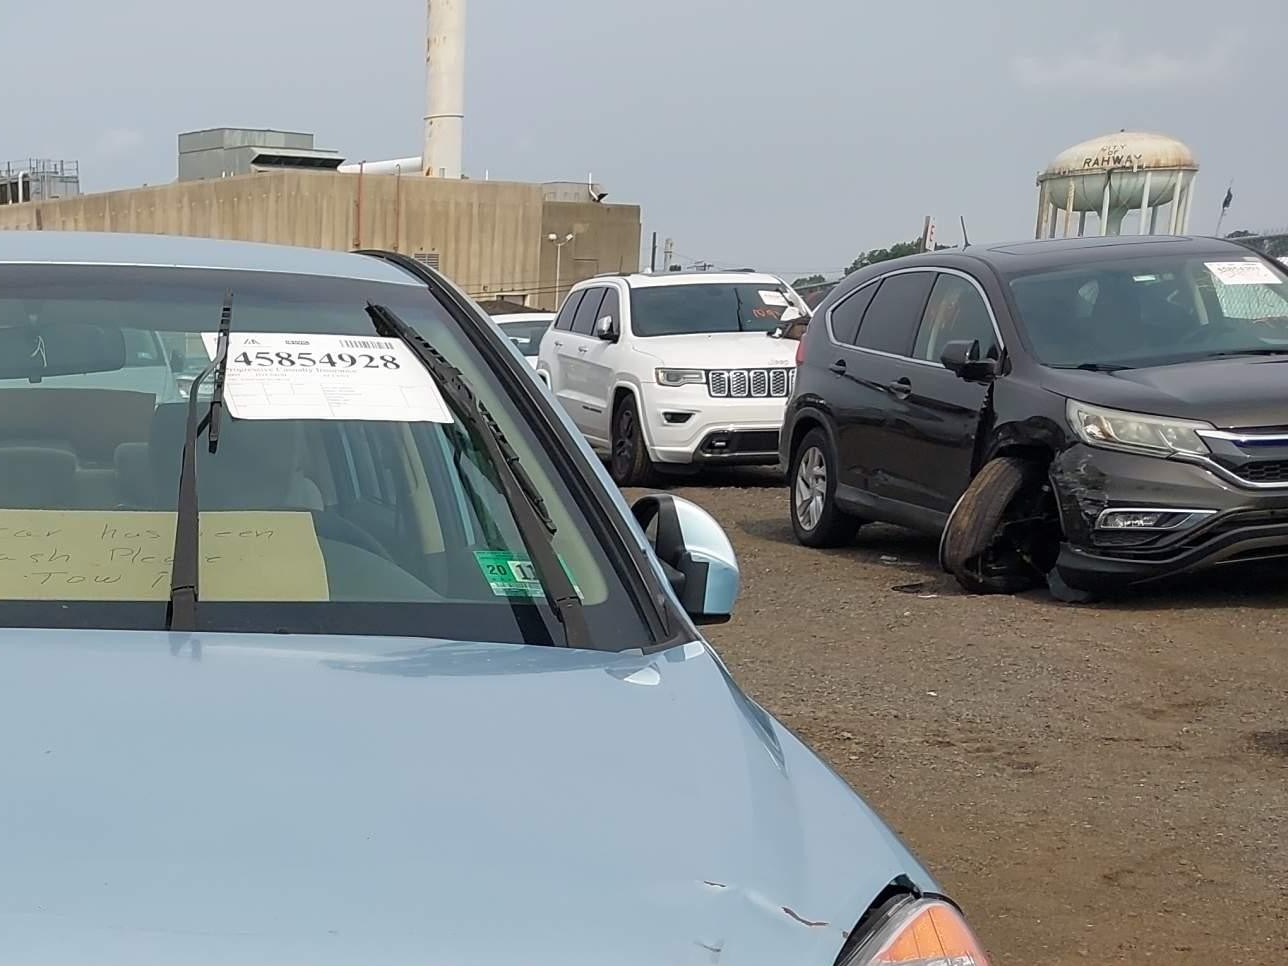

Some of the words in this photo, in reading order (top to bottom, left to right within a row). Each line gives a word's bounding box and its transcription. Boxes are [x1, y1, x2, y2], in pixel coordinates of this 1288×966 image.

[1082, 154, 1142, 168] RAHWAY
[233, 351, 401, 370] 45854928
[487, 564, 508, 577] 20
